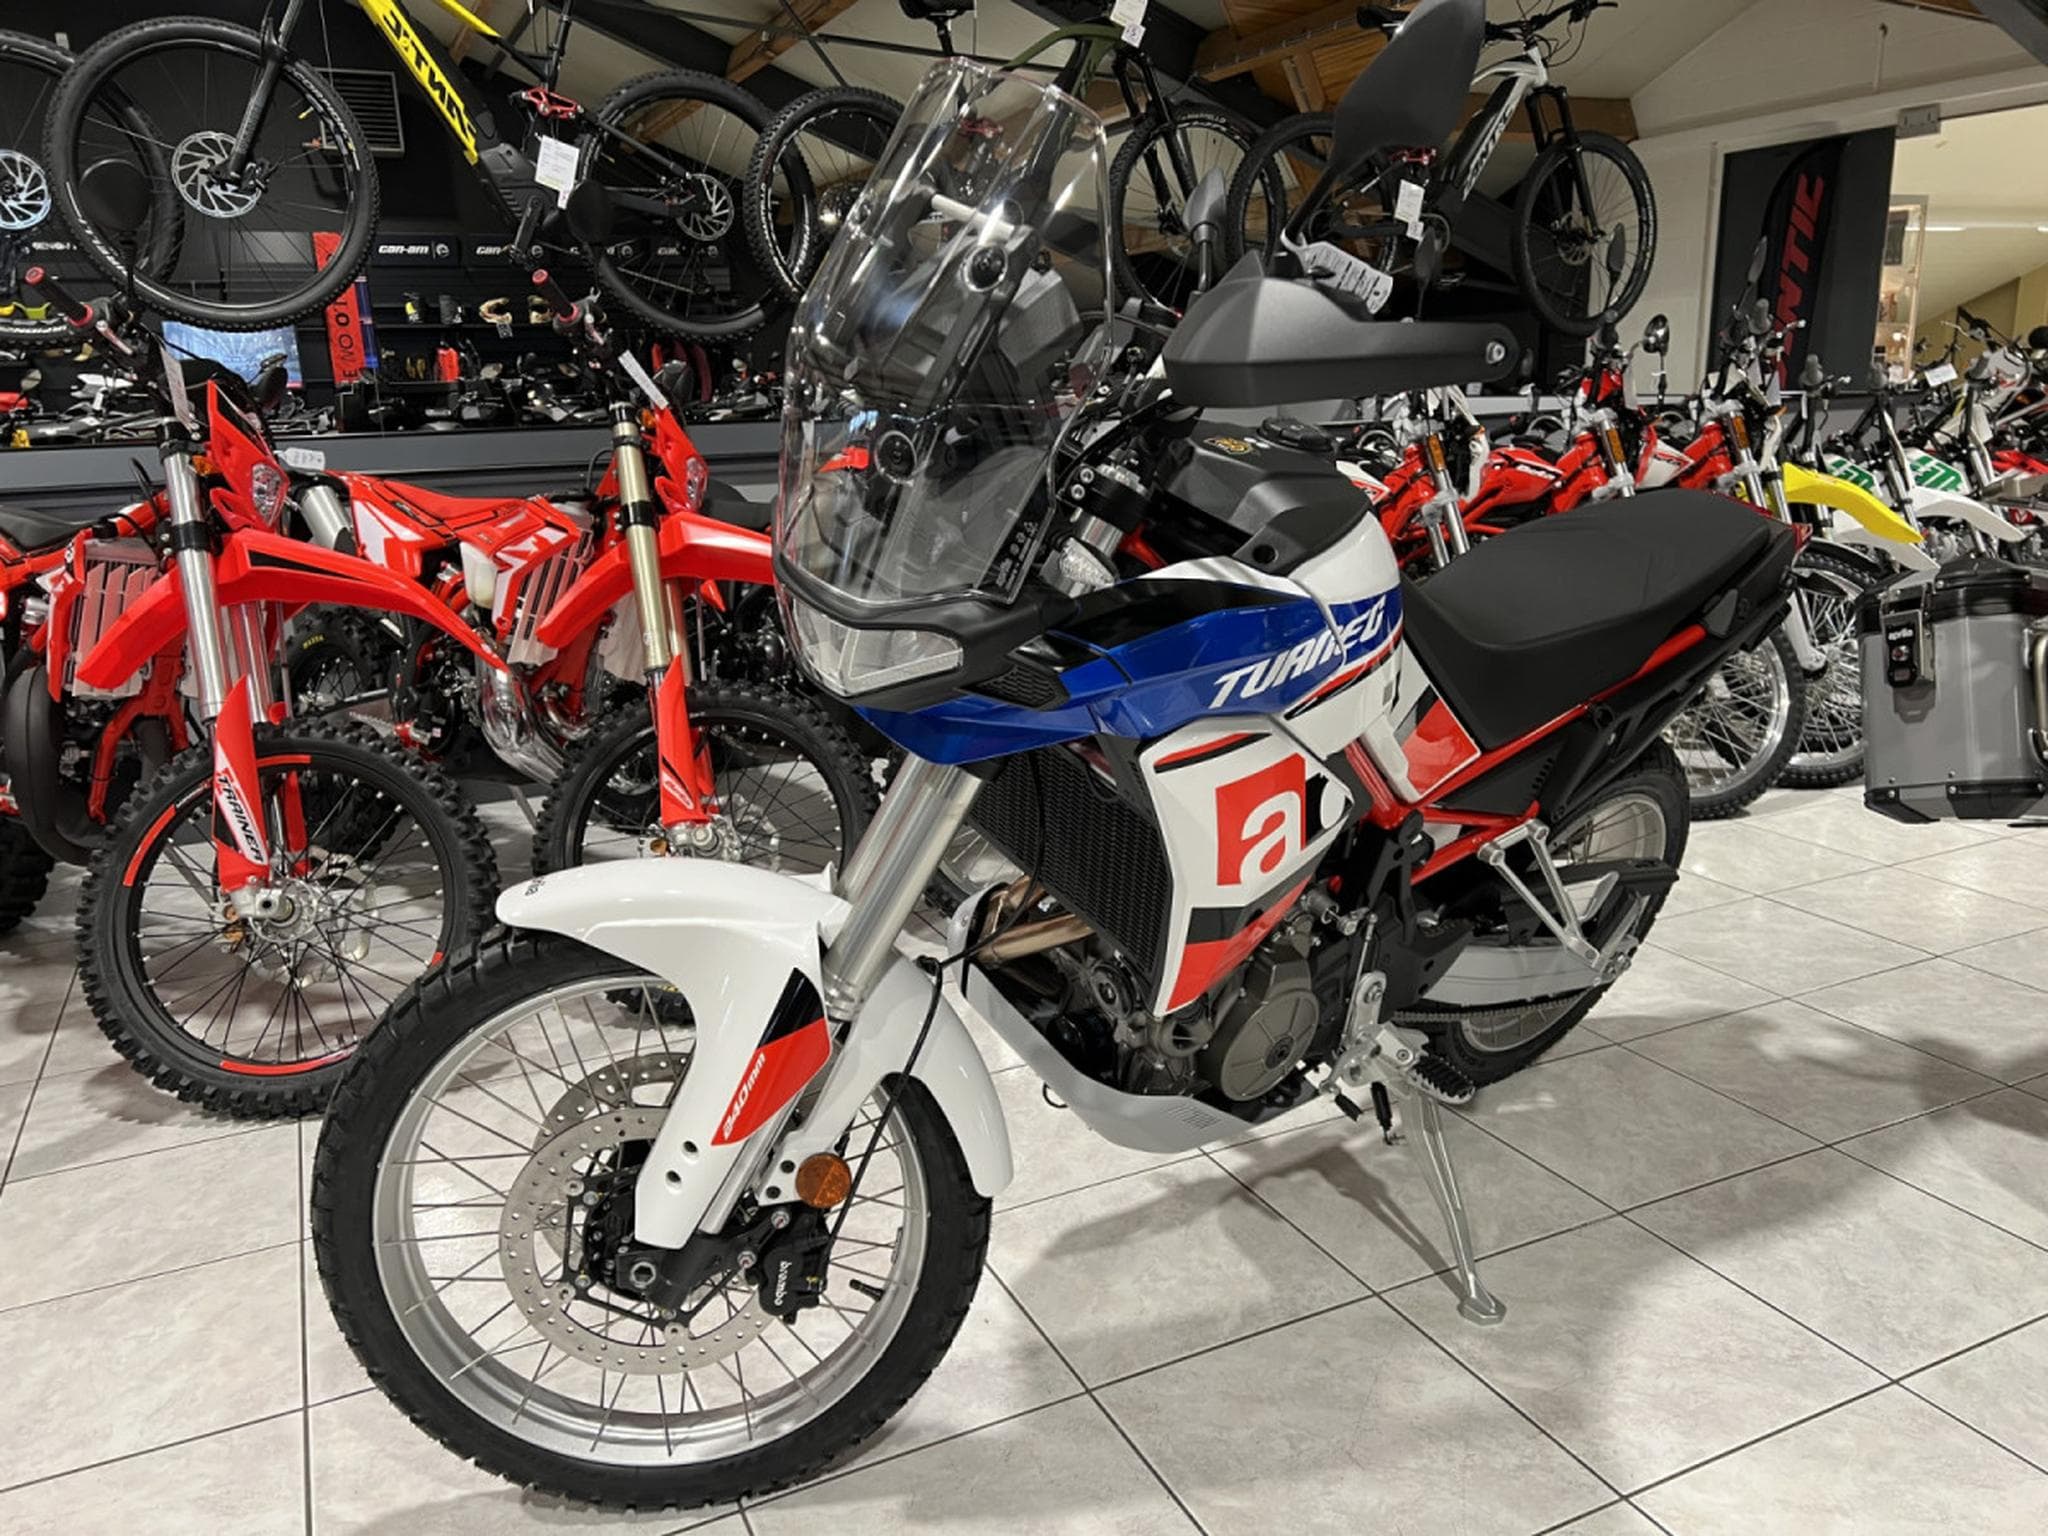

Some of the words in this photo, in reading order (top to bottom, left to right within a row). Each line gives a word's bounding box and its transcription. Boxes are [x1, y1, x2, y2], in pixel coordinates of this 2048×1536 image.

[378, 245, 430, 255] can-am
[1770, 173, 1825, 392] ANTIC
[1208, 594, 1387, 710] TUAREG
[218, 775, 264, 862] TRAINER
[774, 1260, 792, 1306] brembo
